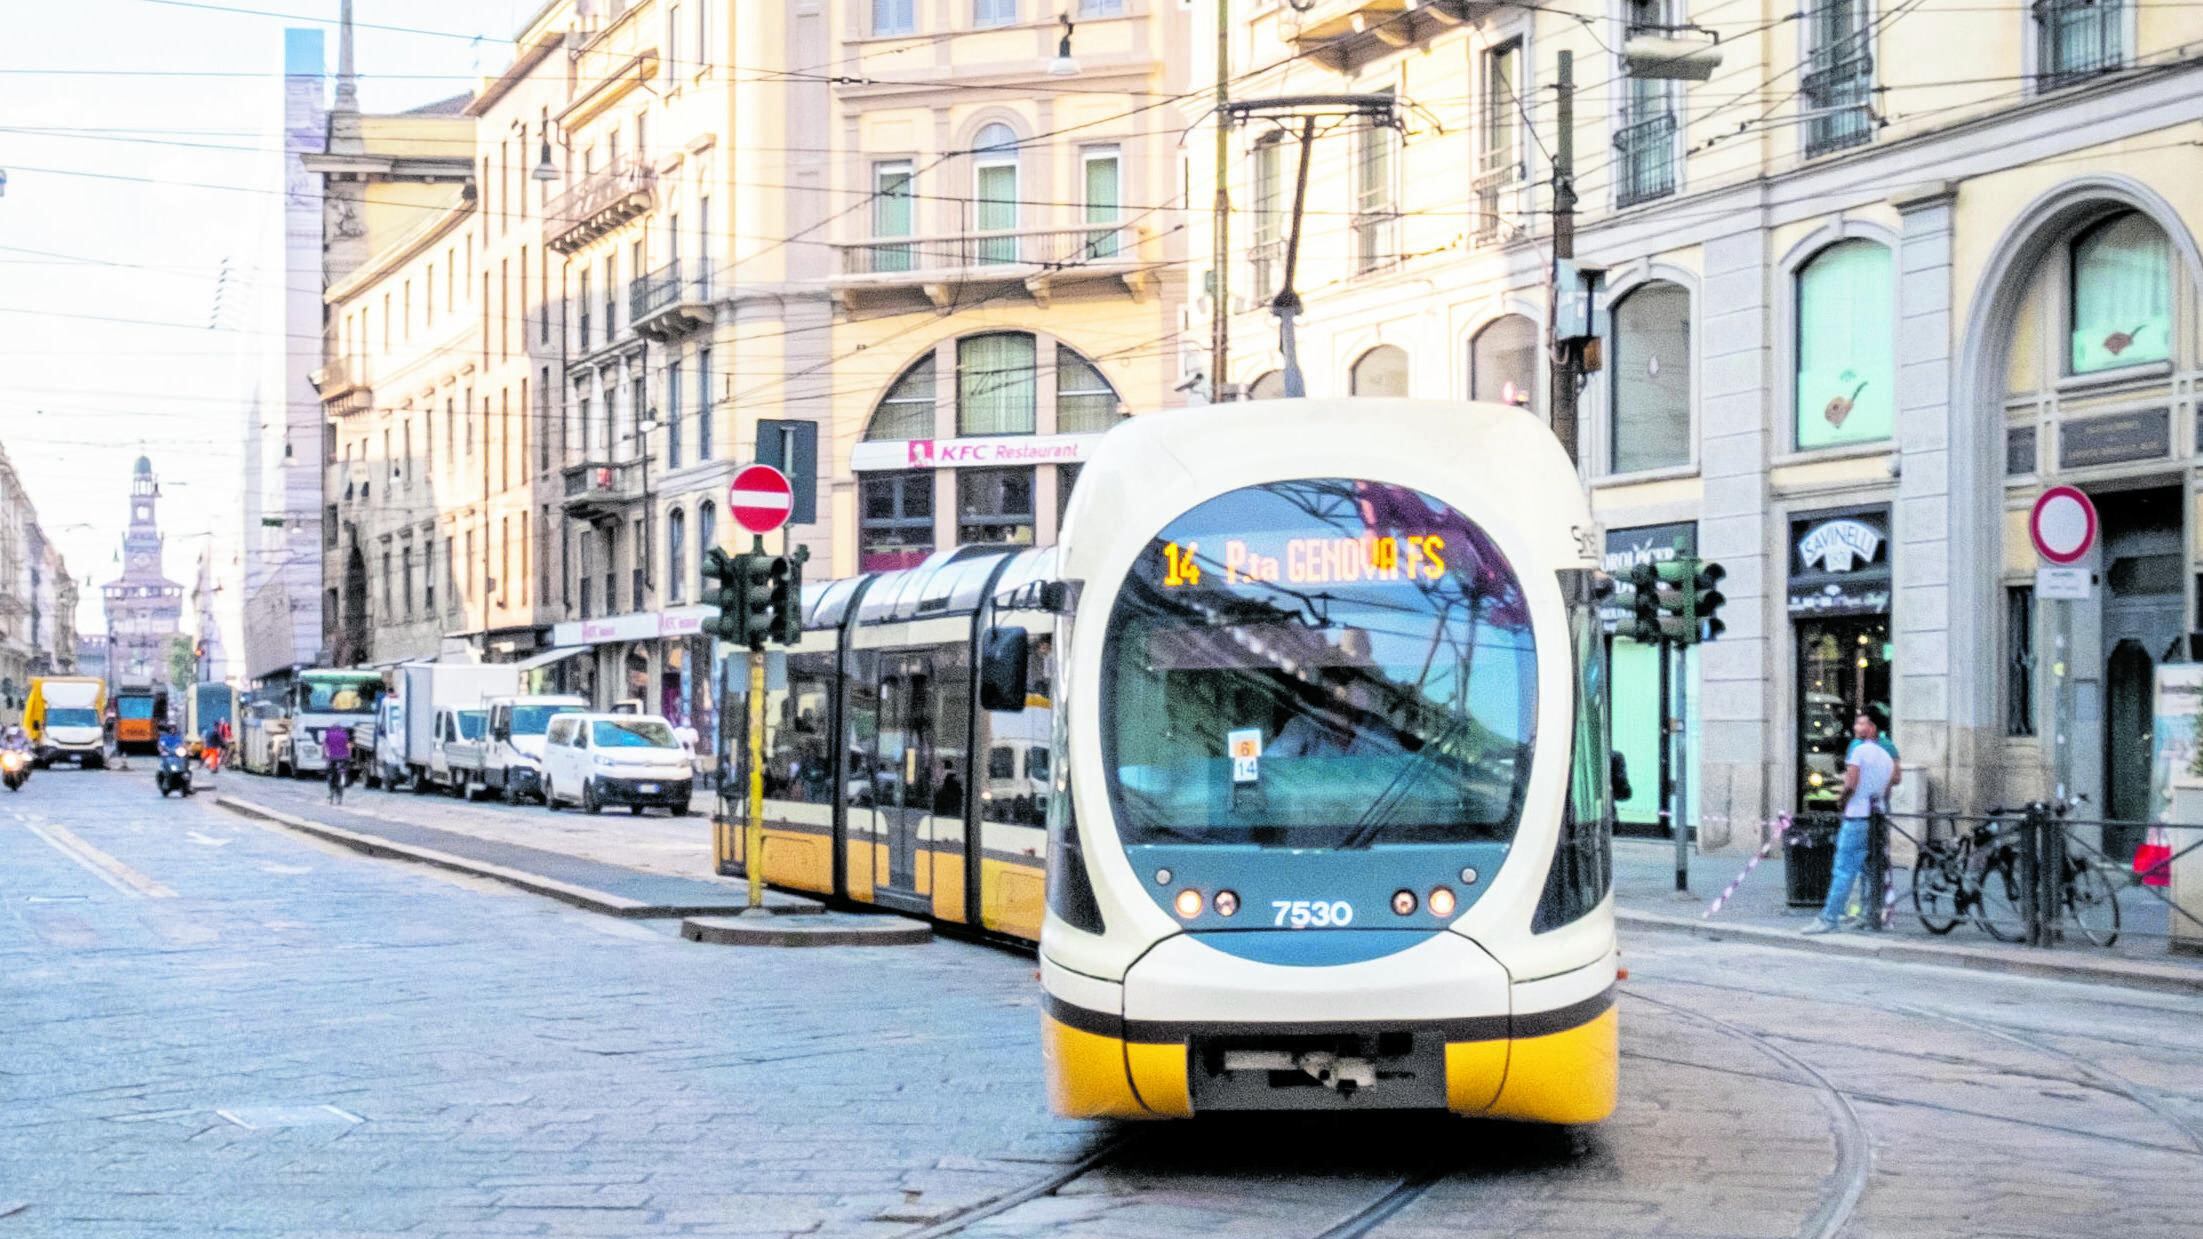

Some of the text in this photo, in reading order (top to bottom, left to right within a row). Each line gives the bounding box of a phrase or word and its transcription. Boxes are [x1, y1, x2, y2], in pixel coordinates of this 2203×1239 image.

[941, 443, 1078, 461] KFC Restaurant
[1803, 523, 1876, 562] SAVINELLI
[1163, 540, 1200, 586] 14
[1287, 536, 1398, 582] GENOVA
[1406, 534, 1446, 580] FS
[1239, 761, 1257, 777] 14
[1271, 900, 1353, 927] 7530
